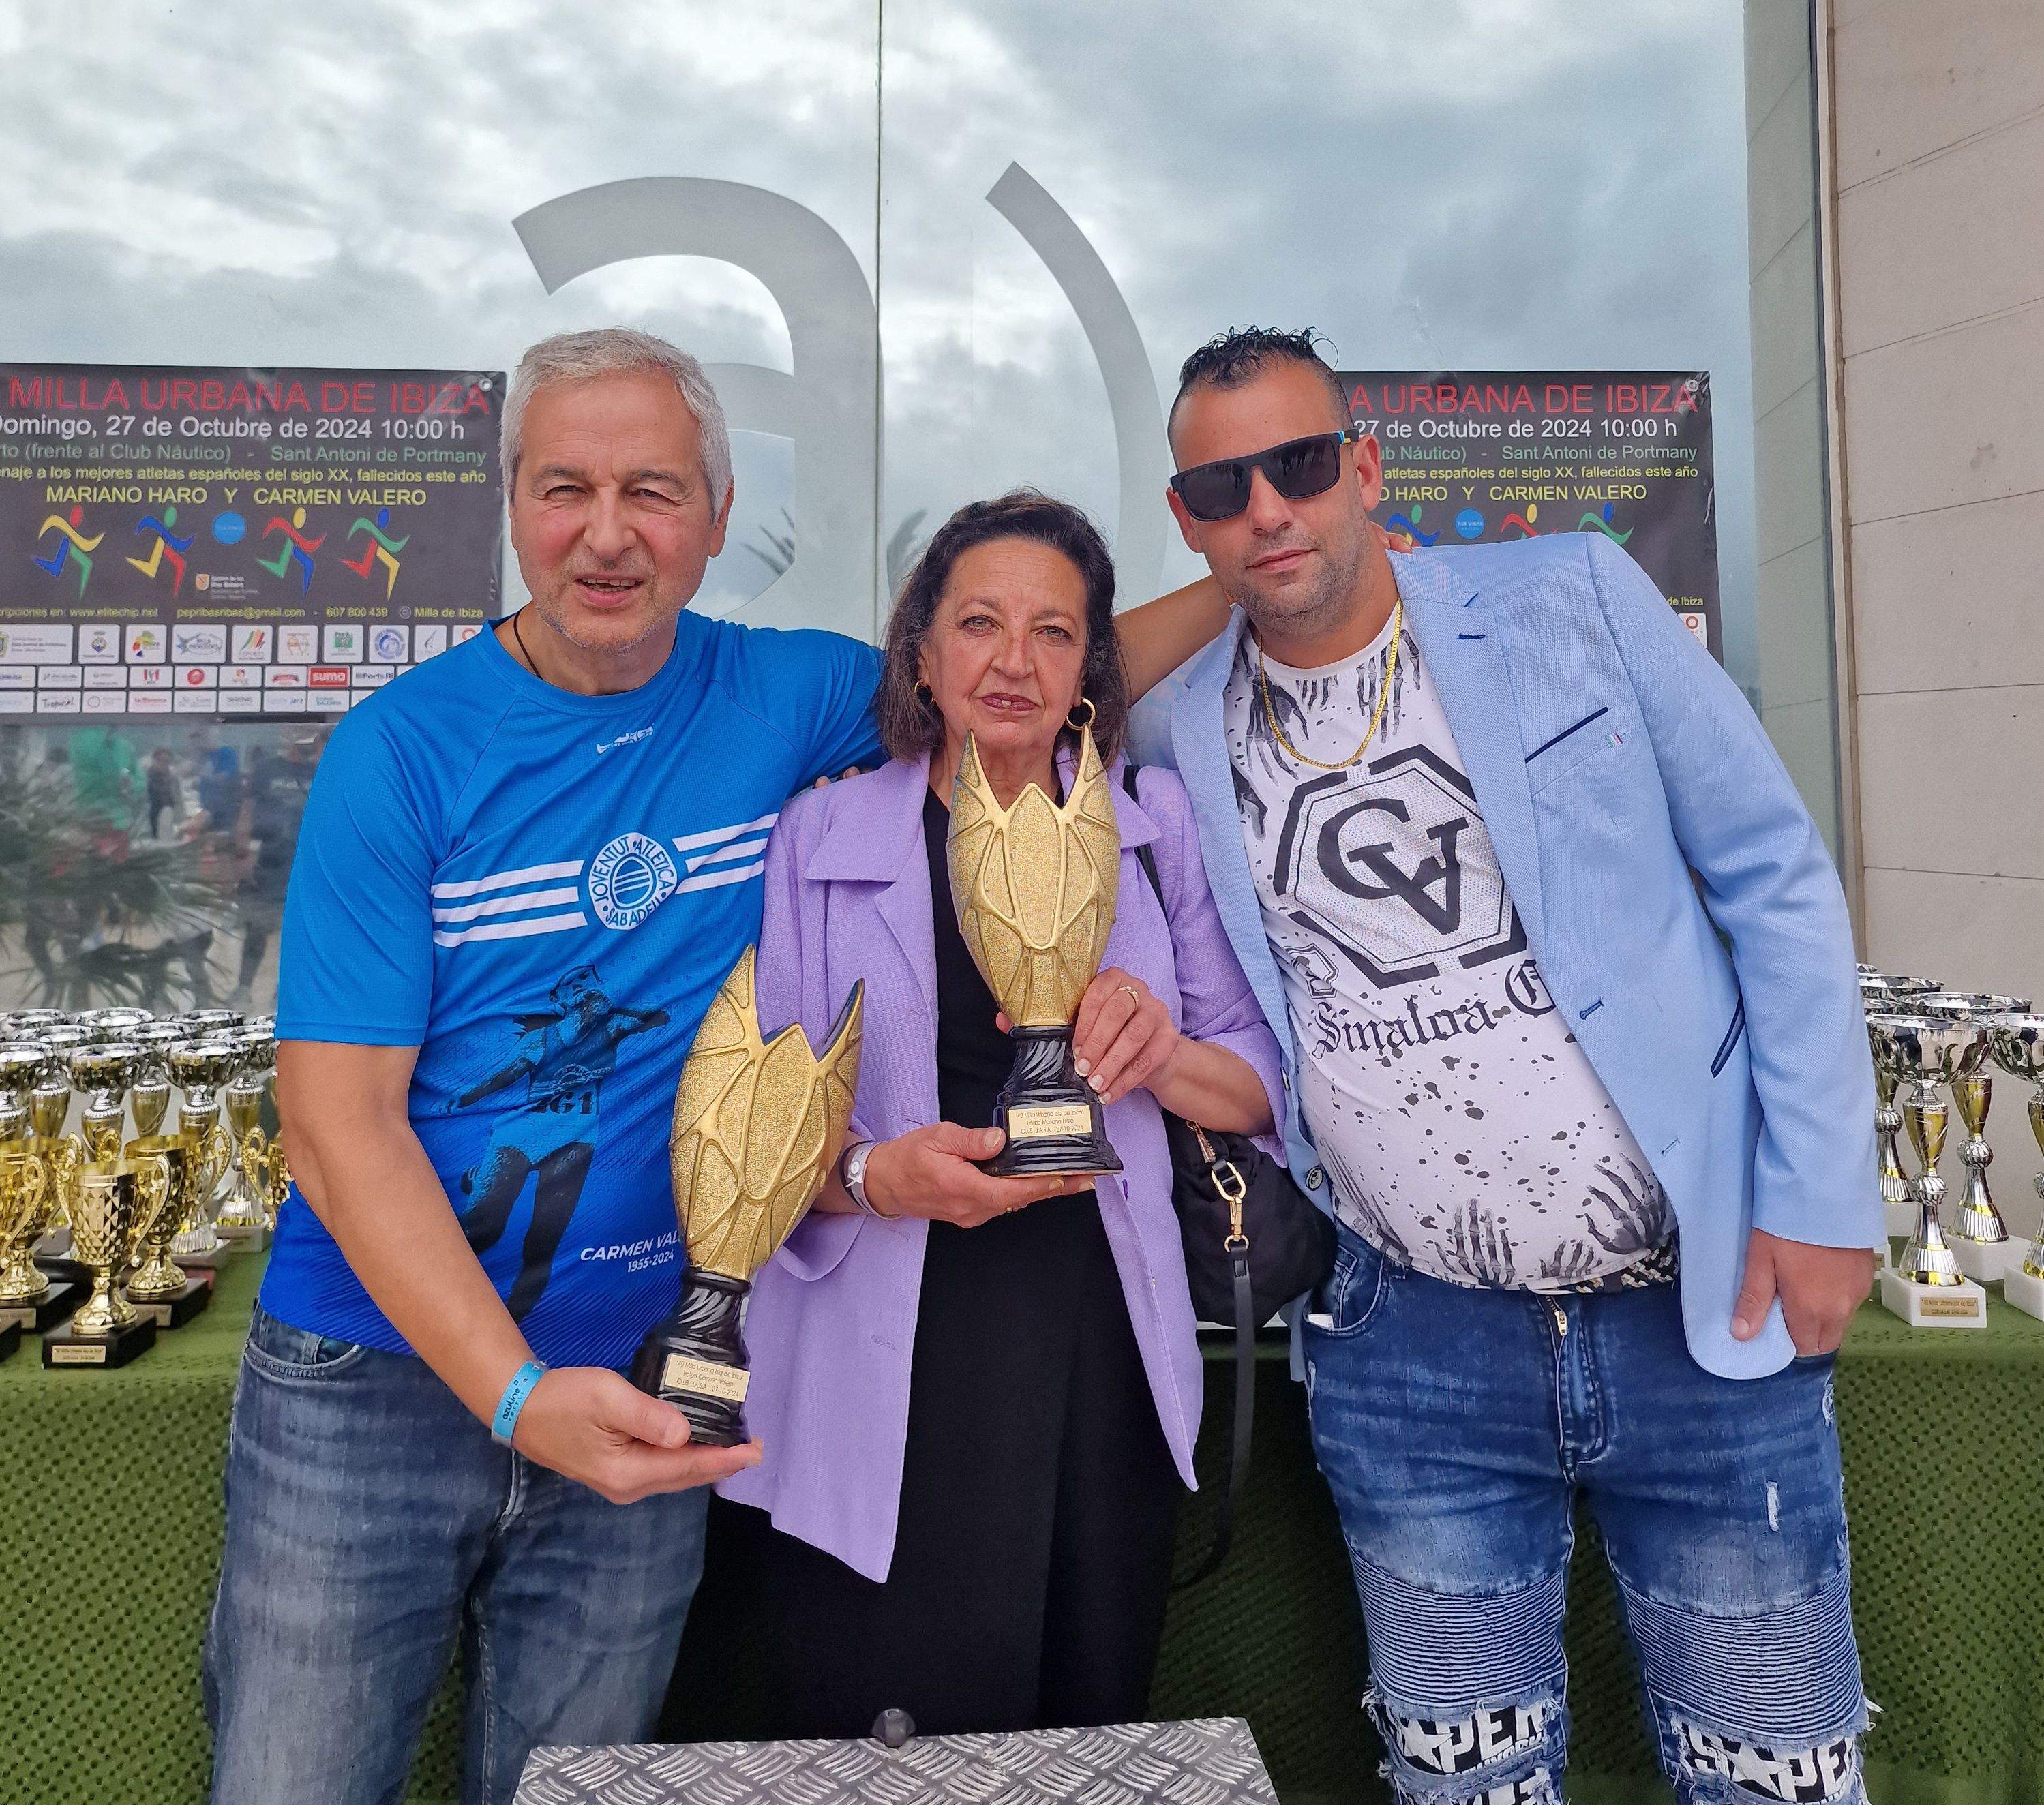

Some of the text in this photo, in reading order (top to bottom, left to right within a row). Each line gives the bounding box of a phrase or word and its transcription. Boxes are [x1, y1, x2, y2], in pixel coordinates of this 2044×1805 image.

[9, 376, 490, 414] MILLA URBANA DE IBIZA
[1382, 384, 1536, 414] URBANA
[1544, 384, 1594, 414] DE
[1606, 384, 1698, 414] IBIZA
[0, 414, 465, 440] omingo, 27 de Octubre de 2024 10:00 h
[1353, 419, 1678, 438] 27 de Octubre de 2024 10:00 h
[25, 443, 82, 461] (frente
[89, 444, 104, 459] al
[110, 444, 151, 460] Club
[157, 444, 231, 464] Náutico)
[271, 445, 312, 462] Sant
[315, 446, 370, 463] Antoni
[376, 447, 397, 464] de
[404, 447, 487, 467] Portmany
[1400, 445, 1466, 464] Náutico)
[1502, 445, 1539, 460] Sant
[1542, 444, 1592, 460] Antoni
[1597, 445, 1617, 459] de
[1623, 444, 1698, 463] Portmany
[37, 468, 46, 479] a
[50, 466, 71, 479] los
[76, 466, 134, 482] mejores
[137, 466, 185, 480] atletas
[189, 467, 260, 483] españoles
[265, 468, 286, 481] del
[291, 468, 324, 484] siglo
[328, 469, 353, 483] XX,
[357, 468, 422, 483] fallecidos
[426, 470, 456, 483] este
[460, 470, 487, 483] año
[1384, 466, 1698, 481] atletas españoles del siglo XX, fallecidos este año
[46, 485, 427, 506] MARIANO HARO Y CARMEN VALERO
[1396, 486, 1448, 501] HARO
[1462, 487, 1475, 501] Y
[1490, 486, 1569, 501] CARMEN
[1573, 485, 1647, 500] VALERO
[1666, 595, 1704, 606] de Ibiza
[326, 607, 346, 618] 607
[348, 607, 366, 618] 800
[369, 607, 389, 618] 439
[415, 607, 439, 618] Milla
[442, 607, 456, 618] de
[459, 607, 484, 618] Ibiza
[590, 836, 629, 902] JOVENTUT
[580, 1229, 680, 1261] CARMEN VAL
[627, 1250, 674, 1273] 1955-2024
